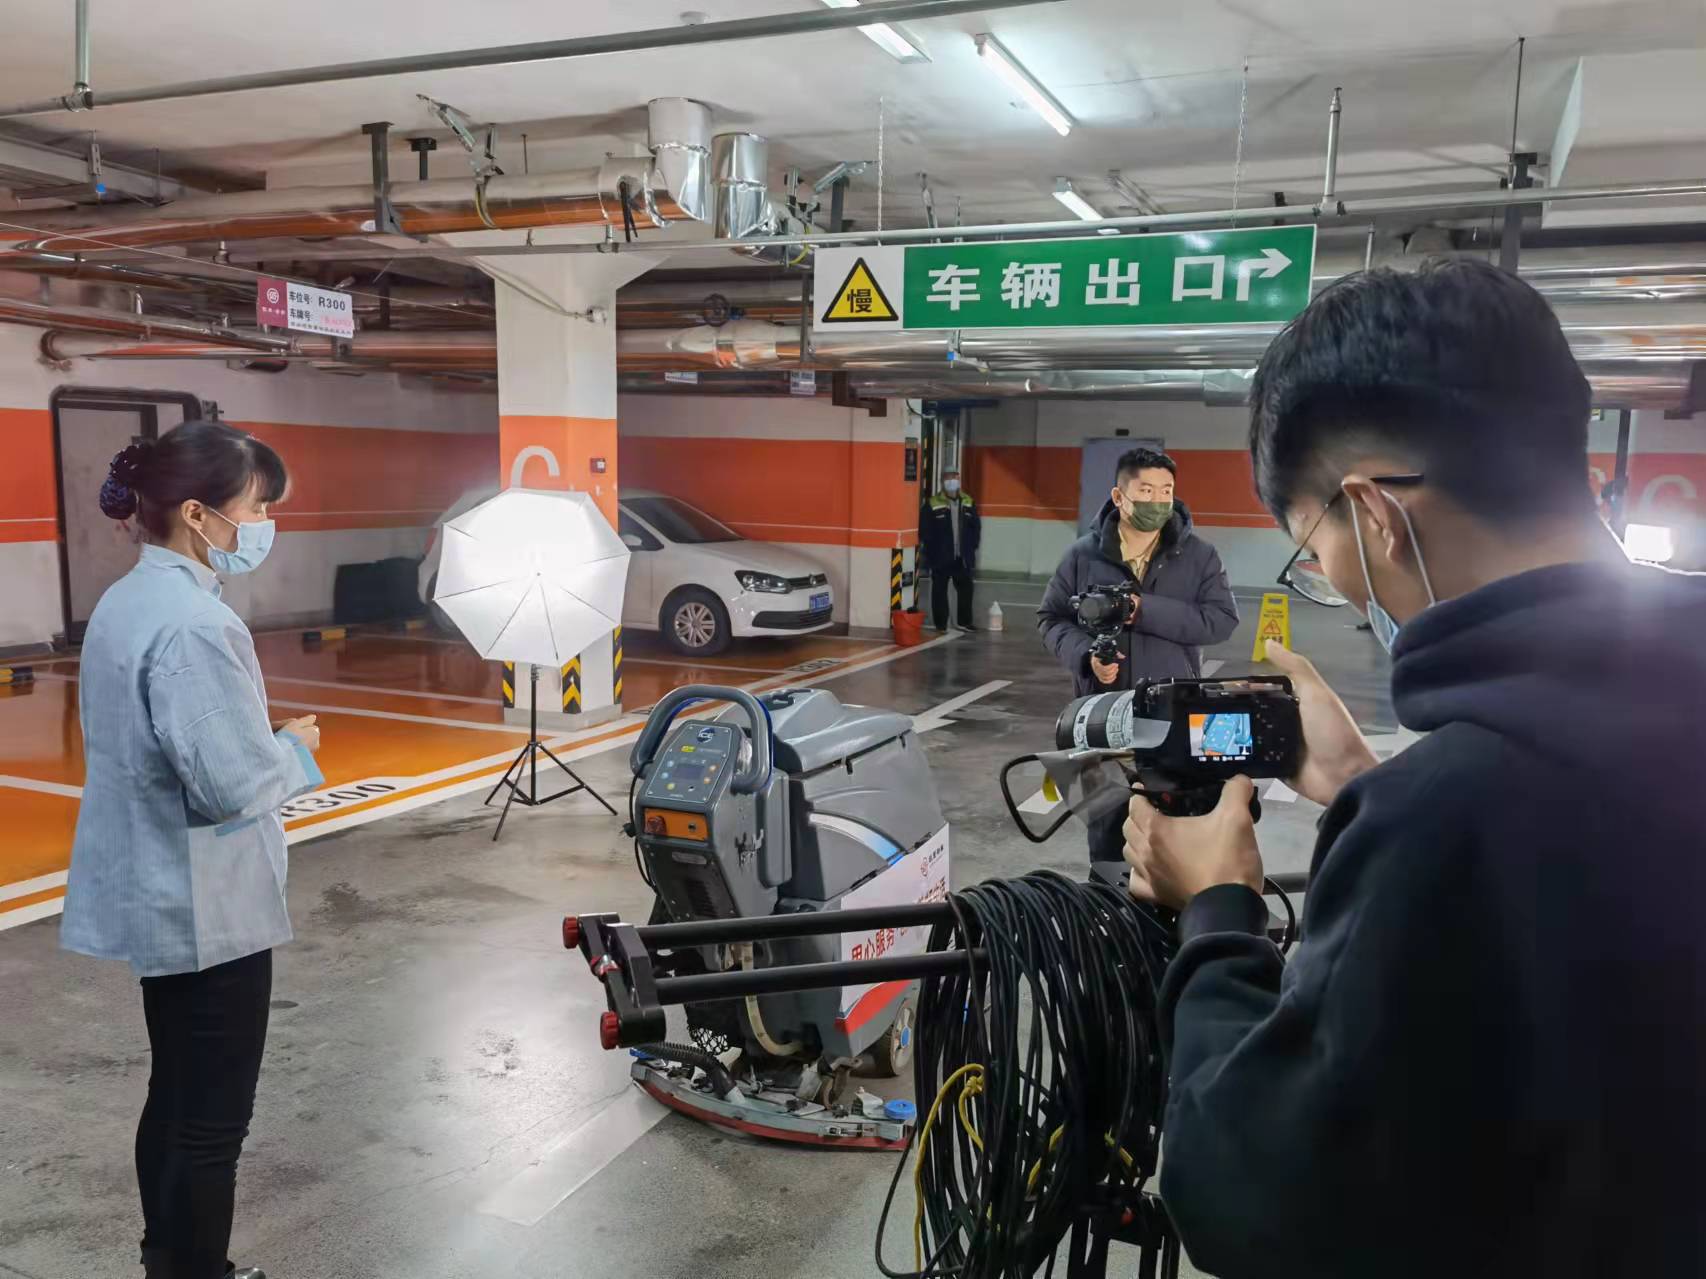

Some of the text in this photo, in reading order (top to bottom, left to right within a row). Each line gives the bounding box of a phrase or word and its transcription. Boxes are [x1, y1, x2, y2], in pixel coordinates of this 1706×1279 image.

[926, 255, 1225, 311] 车辆出口
[318, 296, 346, 311] R300
[847, 288, 873, 314] 慢
